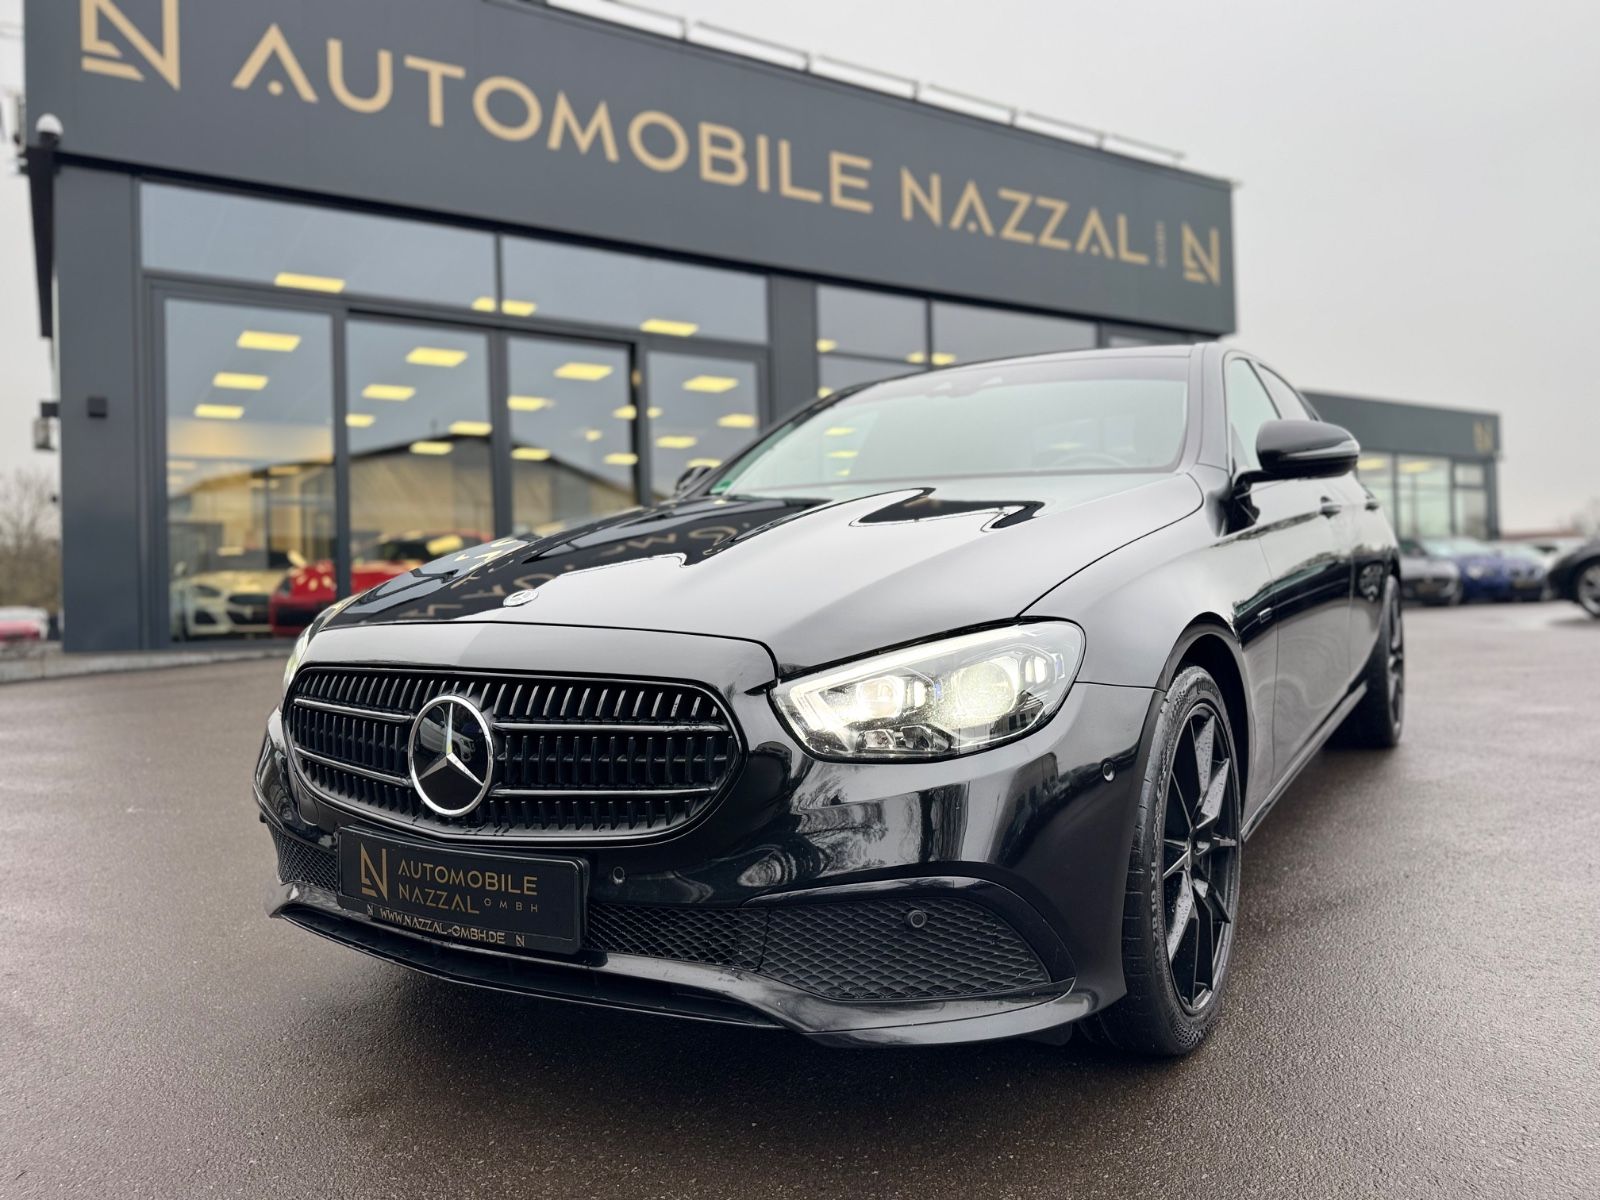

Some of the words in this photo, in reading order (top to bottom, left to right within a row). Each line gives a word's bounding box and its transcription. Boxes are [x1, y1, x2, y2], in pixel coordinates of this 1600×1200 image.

[231, 23, 873, 214] AUTOMOBILE
[900, 168, 1150, 266] NAZZAL
[397, 858, 538, 896] AUTOMOBILE
[398, 882, 481, 915] NAZZAL
[379, 907, 507, 945] WWW.NAZZAL-GMBH.DE
